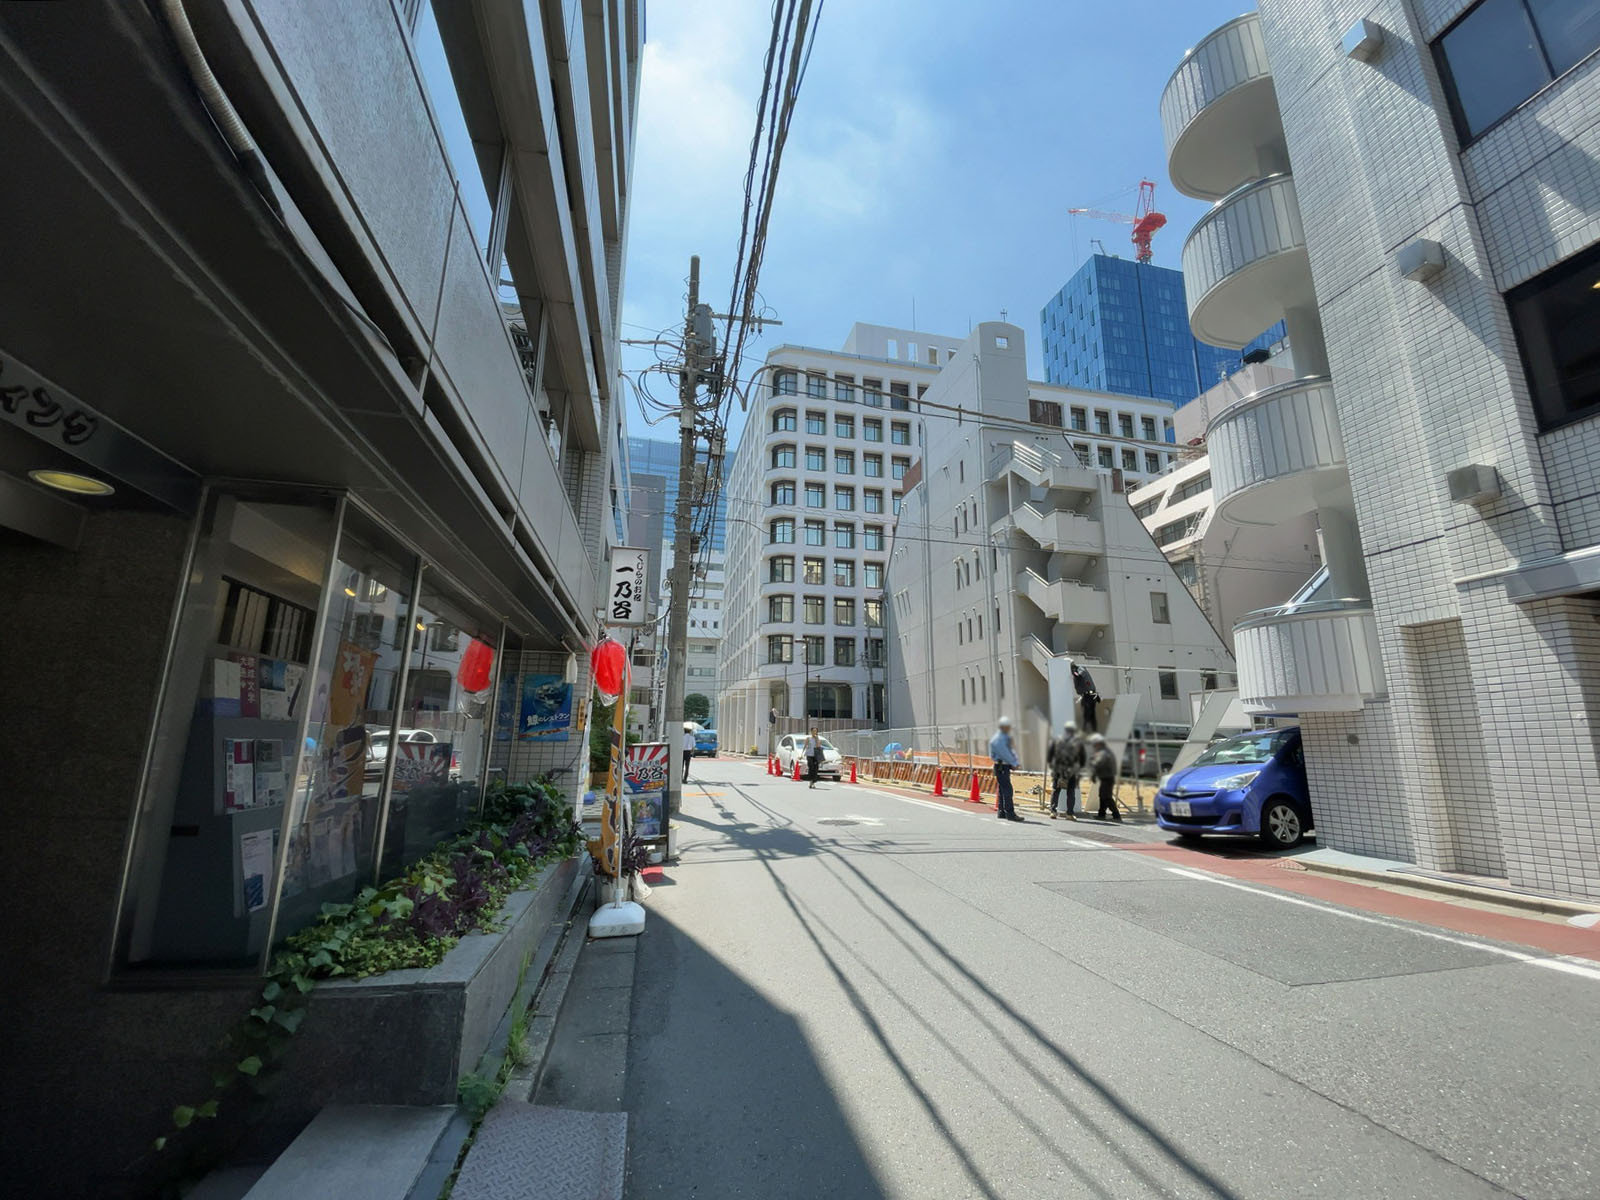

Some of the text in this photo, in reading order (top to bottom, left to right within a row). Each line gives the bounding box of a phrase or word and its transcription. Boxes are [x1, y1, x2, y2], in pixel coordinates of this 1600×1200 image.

[612, 566, 634, 619] 一乃谷
[624, 767, 664, 779] 一乃谷
